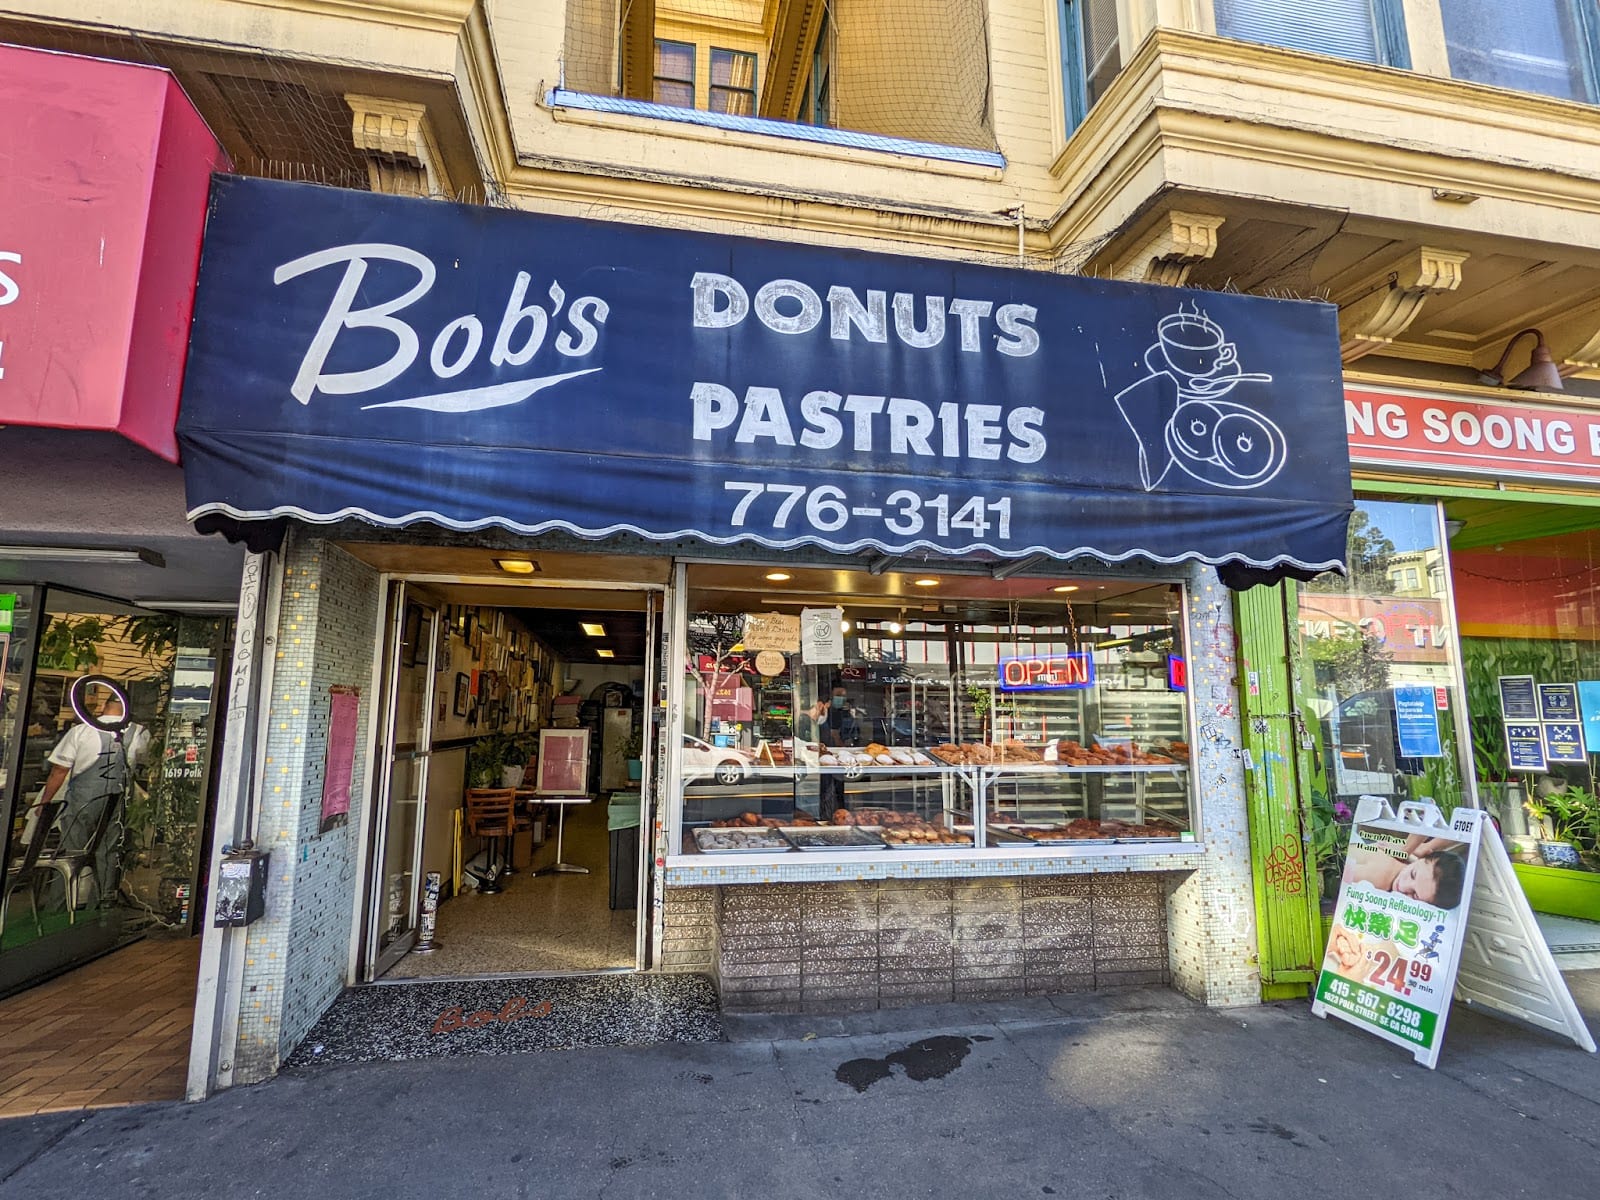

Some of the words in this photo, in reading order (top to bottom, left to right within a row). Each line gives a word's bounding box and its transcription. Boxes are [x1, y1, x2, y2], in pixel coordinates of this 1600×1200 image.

[273, 243, 609, 405] Bob's
[690, 272, 1040, 357] DONUTS
[690, 382, 1047, 463] PASTRIES
[1422, 408, 1576, 455] SOONG
[725, 481, 1011, 540] 776-3141
[1005, 658, 1087, 686] OPEN
[165, 767, 182, 778] 1619
[184, 767, 203, 778] Polk
[1346, 886, 1364, 903] Fung
[1365, 891, 1387, 910] Soong
[1418, 984, 1433, 994] min
[1354, 1005, 1379, 1022] STREET
[1389, 1019, 1400, 1031] CA
[1400, 1024, 1424, 1041] 94109
